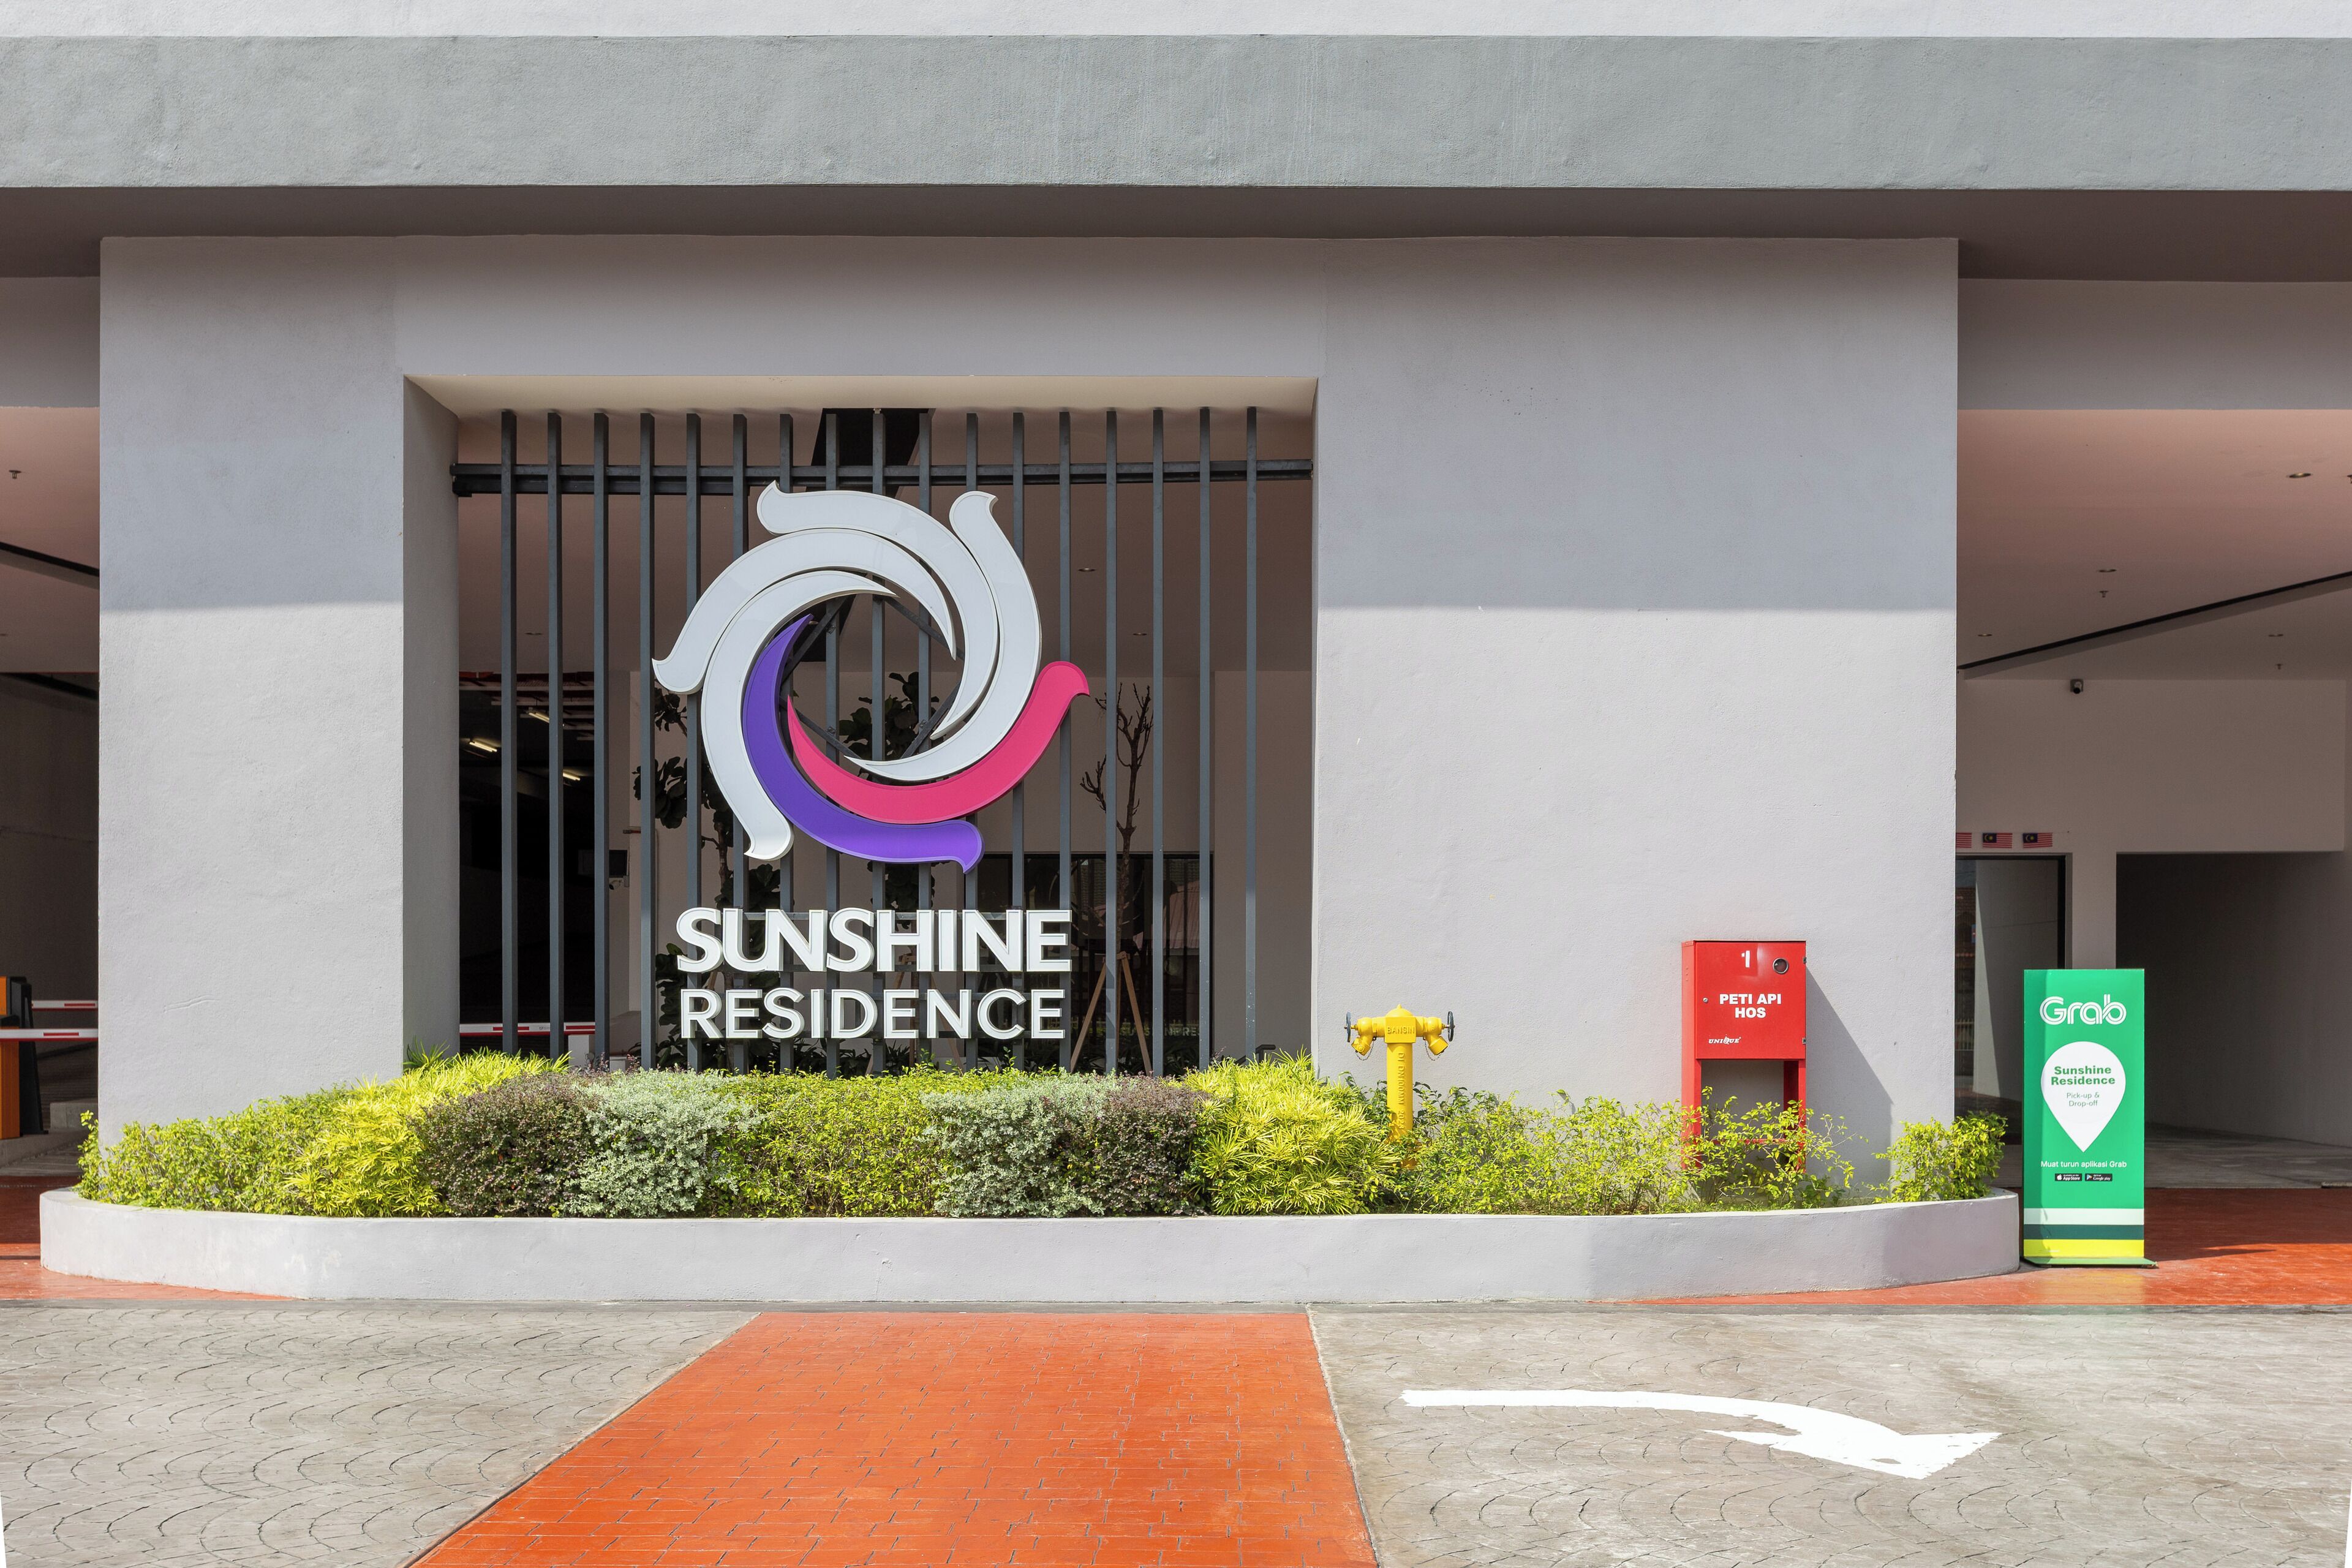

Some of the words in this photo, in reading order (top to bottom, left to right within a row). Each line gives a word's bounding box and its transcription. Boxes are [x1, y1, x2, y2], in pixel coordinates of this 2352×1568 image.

[676, 907, 1072, 973] SUNSHINE
[1741, 950, 1751, 968] 1
[1719, 993, 1752, 1005] PETI
[1756, 993, 1782, 1005] API
[680, 988, 1066, 1039] RESIDENCE
[1735, 1007, 1766, 1018] HOS
[2039, 993, 2127, 1025] Grab
[2054, 1065, 2112, 1075] Sunshine
[2051, 1076, 2116, 1085] Residence
